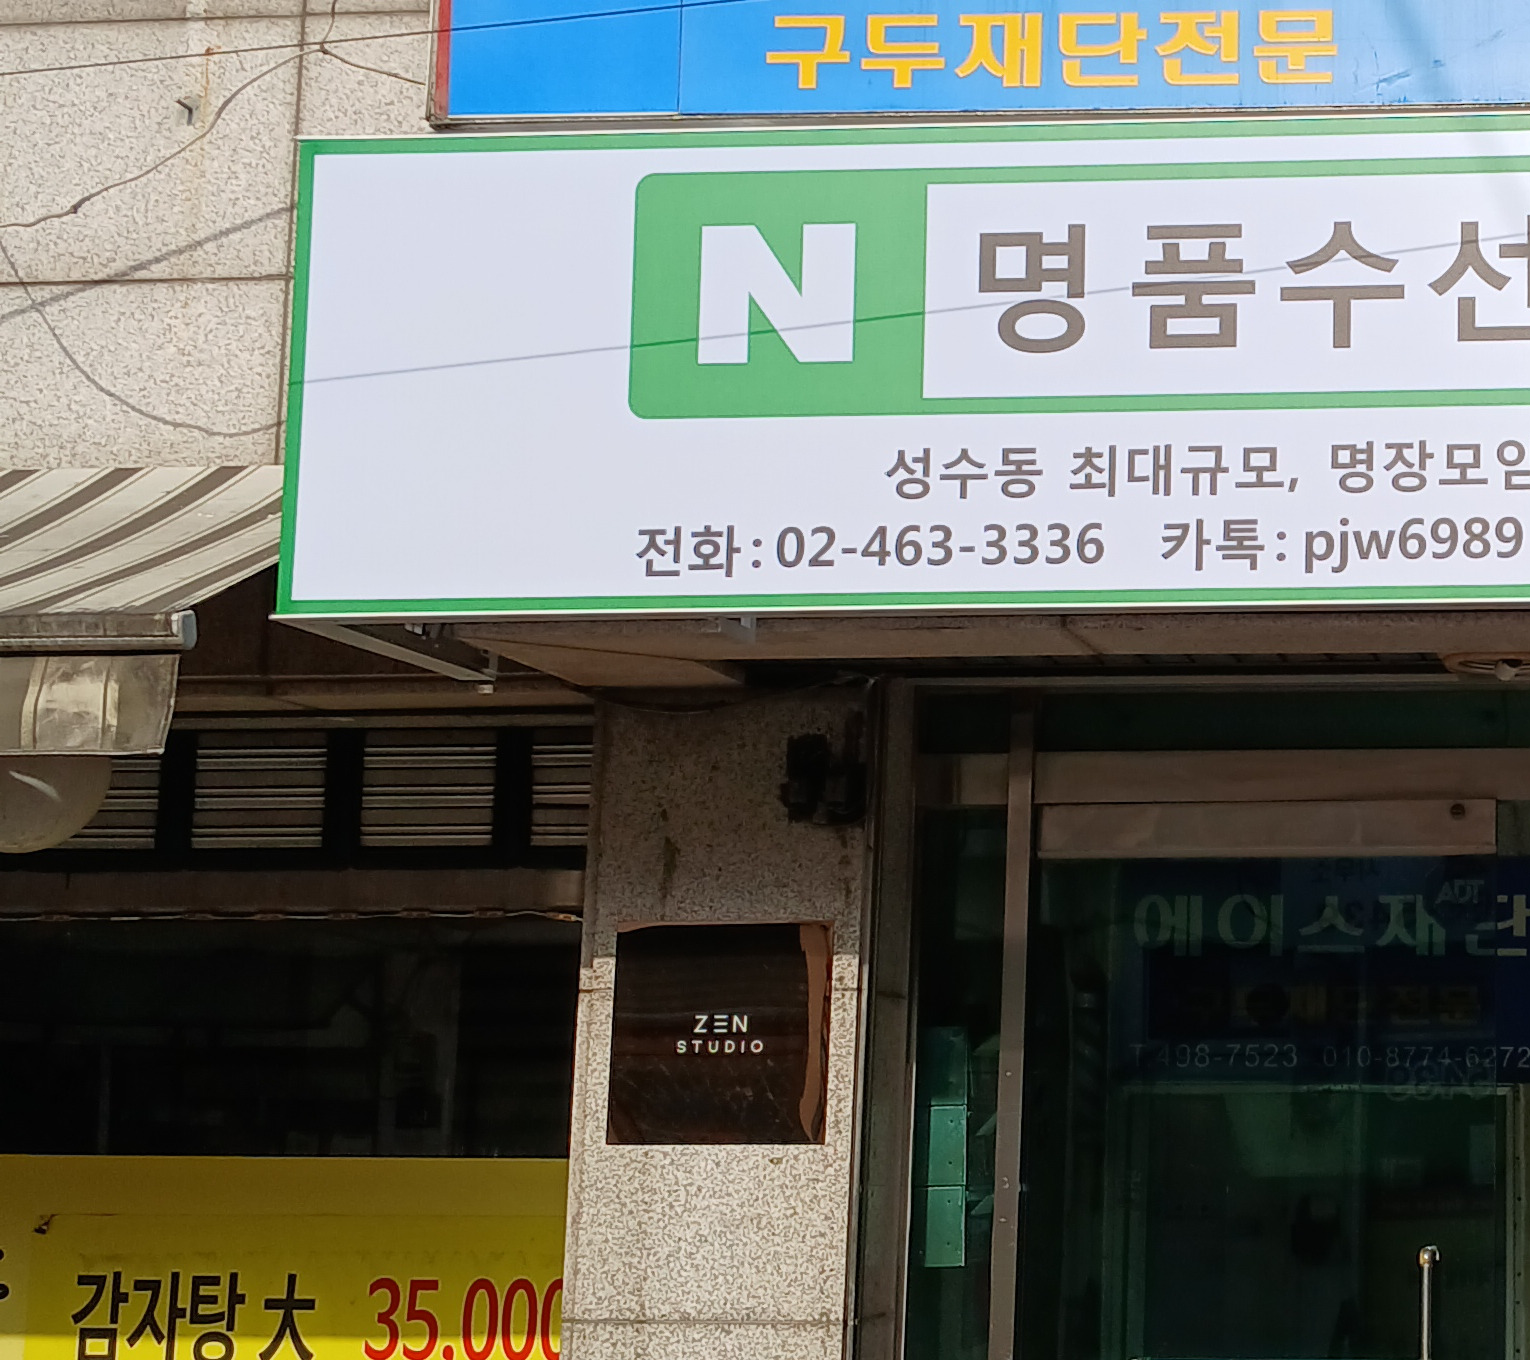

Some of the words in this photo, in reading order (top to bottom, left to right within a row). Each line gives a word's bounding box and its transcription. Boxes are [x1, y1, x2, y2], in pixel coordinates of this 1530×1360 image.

[766, 9, 1338, 90] 구두재단전문
[697, 222, 856, 365] N
[885, 447, 1044, 500] 성수동
[1069, 443, 1299, 498] 최대규모,
[635, 522, 1105, 578] 전화:02-463-3336
[1161, 516, 1524, 574] 카톡:pjw6989
[675, 1039, 765, 1055] STUDIO
[692, 1014, 749, 1034] ZEN
